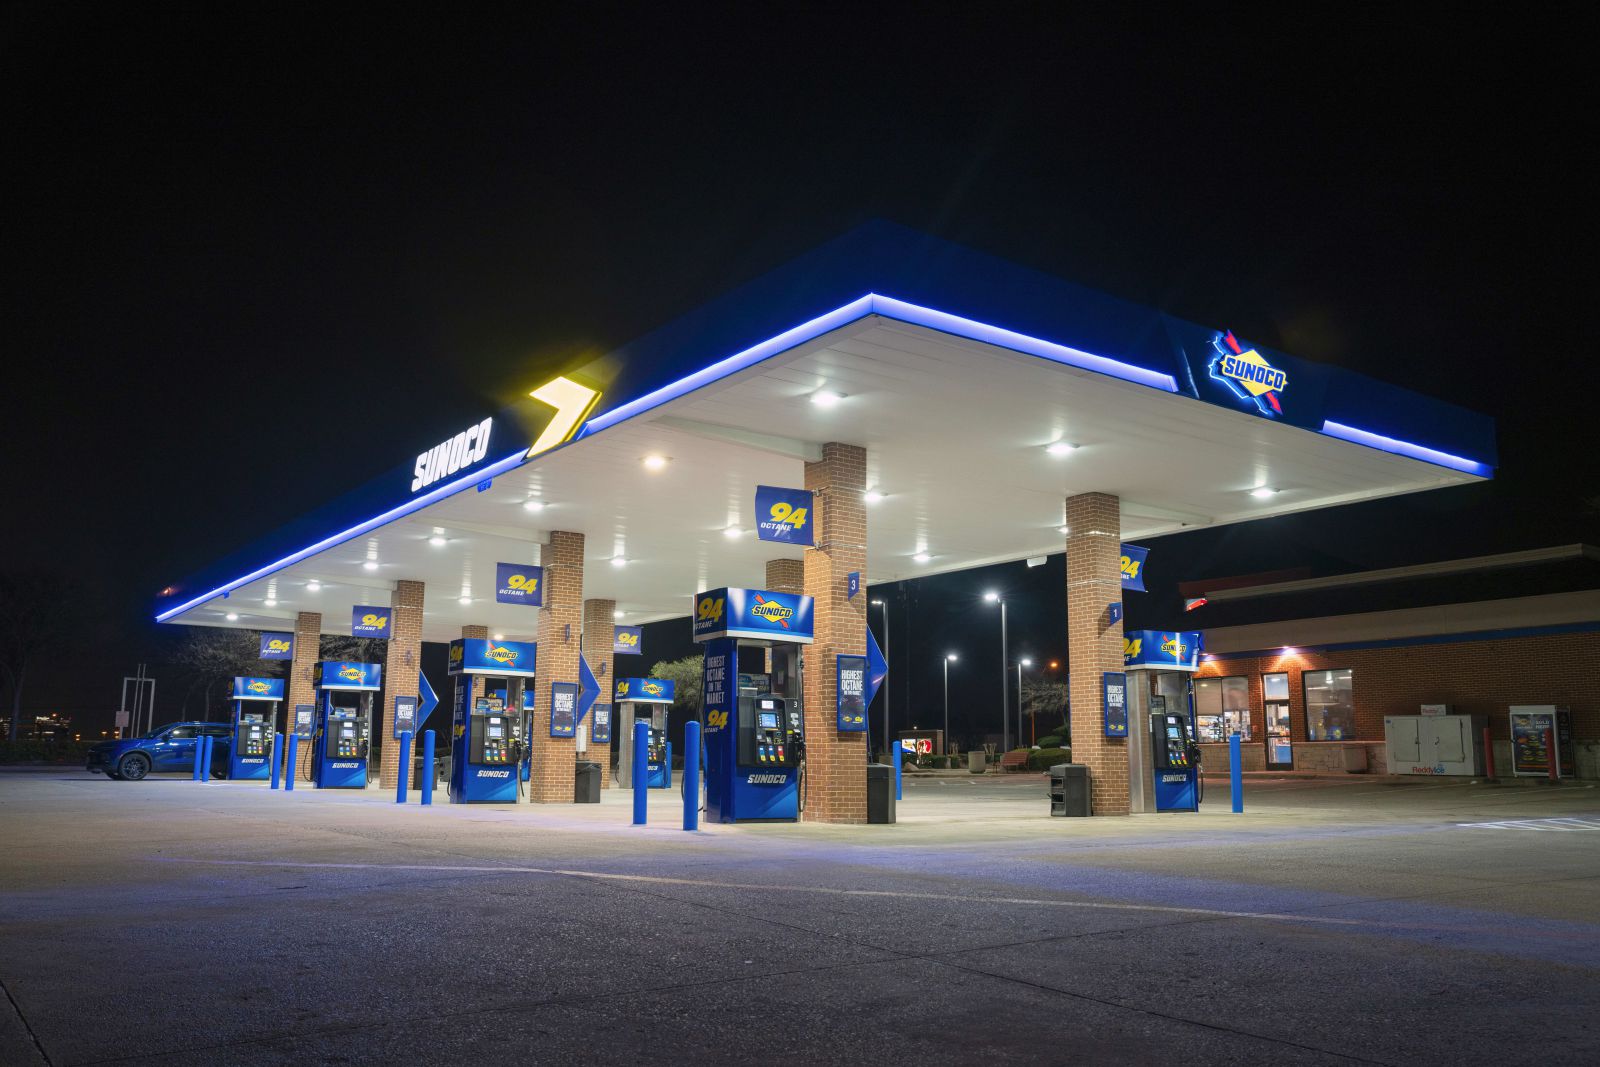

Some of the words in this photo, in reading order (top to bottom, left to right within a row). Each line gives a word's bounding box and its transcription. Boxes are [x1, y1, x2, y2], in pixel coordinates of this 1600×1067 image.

[1225, 356, 1285, 390] SUNOCO
[411, 416, 493, 493] SUNOCO
[770, 502, 807, 529] 94
[760, 522, 792, 532] OCTANE
[508, 574, 539, 595] 94
[851, 579, 856, 590] 3
[698, 598, 724, 622] 94
[753, 606, 792, 618] SUNOCO
[1113, 608, 1118, 618] 1
[362, 614, 388, 630] 94
[268, 639, 291, 652] 94
[618, 632, 639, 647] 94
[487, 650, 517, 659] SUNOCO
[707, 655, 725, 668] HIGHEST
[706, 668, 725, 682] OCTANE
[841, 669, 863, 680] HIGHEST
[618, 682, 629, 695] 94
[708, 682, 714, 692] ON
[714, 681, 722, 691] THE
[841, 680, 863, 690] OCTANE
[1107, 685, 1124, 693] HIGHEST
[555, 700, 573, 708] OCTANE
[706, 692, 725, 704] MARKET
[1108, 694, 1123, 703] OCTANE
[708, 709, 728, 730] 94
[477, 770, 509, 778] SUNOCO
[747, 774, 787, 784] SUNOCO
[1162, 774, 1187, 783] SUNOCO
